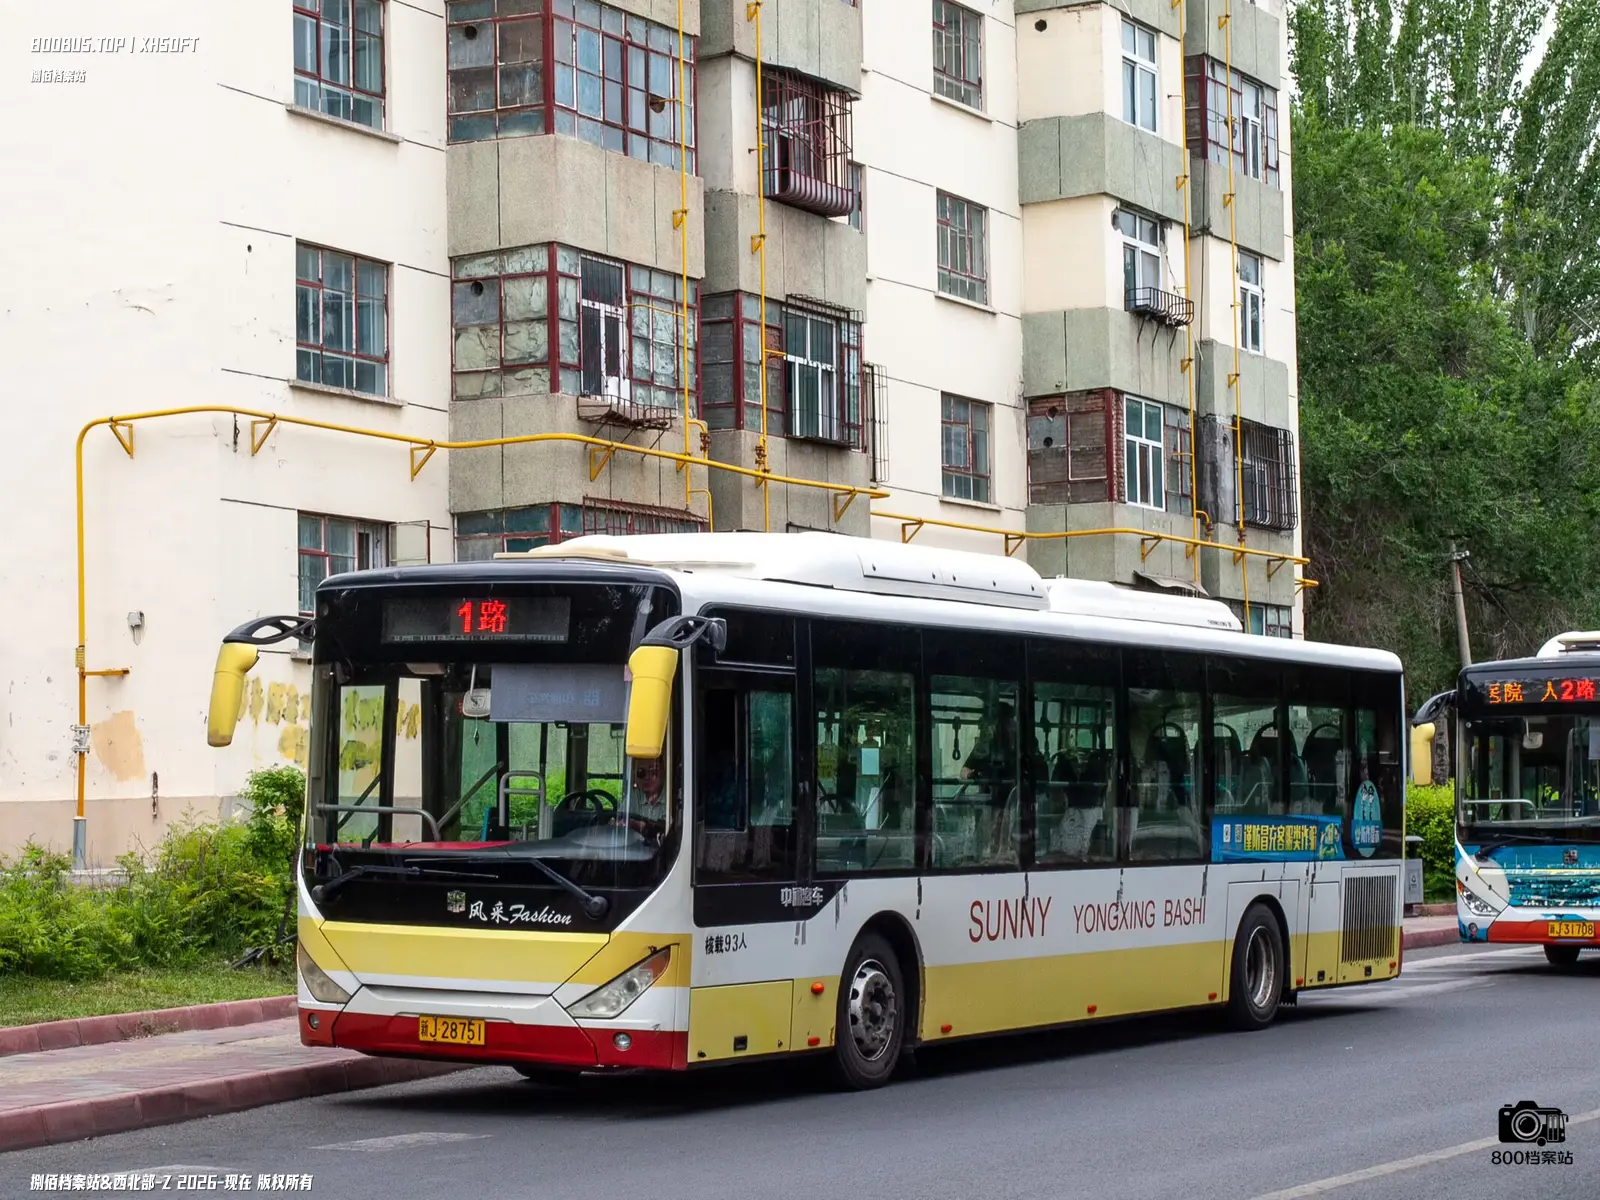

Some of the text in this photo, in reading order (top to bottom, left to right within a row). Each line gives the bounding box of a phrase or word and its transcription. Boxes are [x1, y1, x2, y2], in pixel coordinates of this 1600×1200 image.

[457, 600, 508, 634] 1路
[468, 900, 572, 925] 风采 Fashion
[968, 896, 1207, 942] SUNNY YONGXING BASHI
[704, 932, 748, 955] 核载93人
